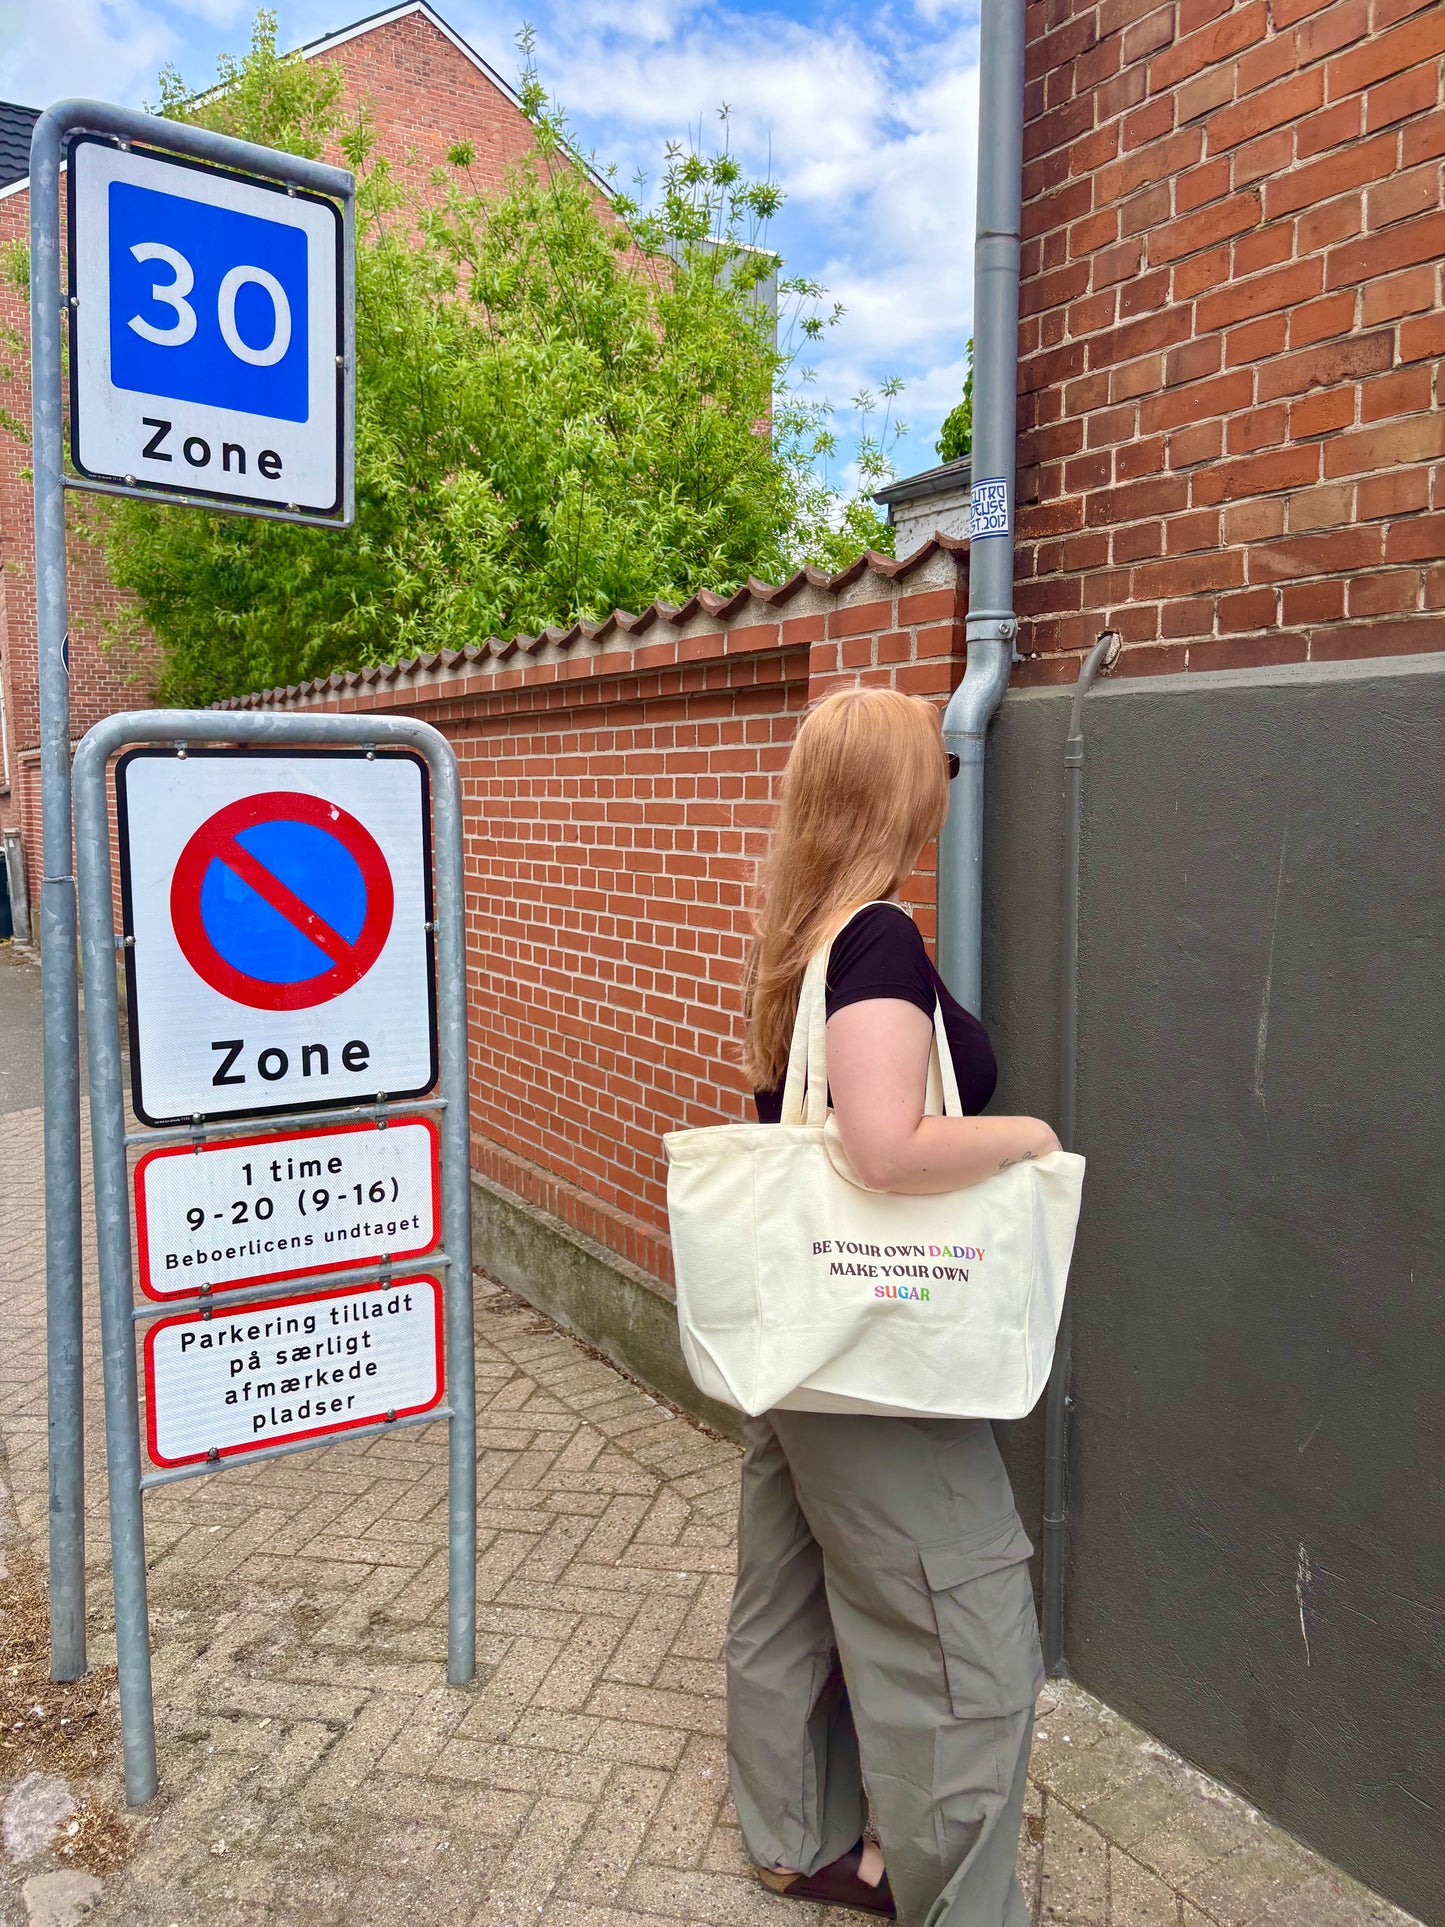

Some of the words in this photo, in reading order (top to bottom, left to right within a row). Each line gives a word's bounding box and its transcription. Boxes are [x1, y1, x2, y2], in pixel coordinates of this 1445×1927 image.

[127, 241, 293, 368] 30
[142, 417, 283, 479] Zone
[211, 1039, 370, 1086] Zone
[242, 1163, 253, 1186] 1
[270, 1157, 343, 1182] time
[186, 1197, 275, 1232] 9-20
[298, 1177, 399, 1216] (9-16)
[166, 1234, 314, 1270] Beboerlicens
[324, 1214, 420, 1243] undtaget
[812, 1240, 832, 1255] BE
[834, 1240, 881, 1257] YOUR
[884, 1245, 925, 1257] OWN
[928, 1245, 985, 1261] DADDY
[829, 1262, 879, 1278] MAKE
[881, 1264, 930, 1278] YOUR
[932, 1266, 970, 1282] OWN
[874, 1285, 930, 1302] SUGAR
[181, 1314, 316, 1352] Parkering
[330, 1294, 413, 1326] tilladt
[230, 1351, 261, 1378] på
[276, 1330, 372, 1365] særligt
[225, 1360, 378, 1405] afmærkede
[253, 1393, 356, 1433] pladser
